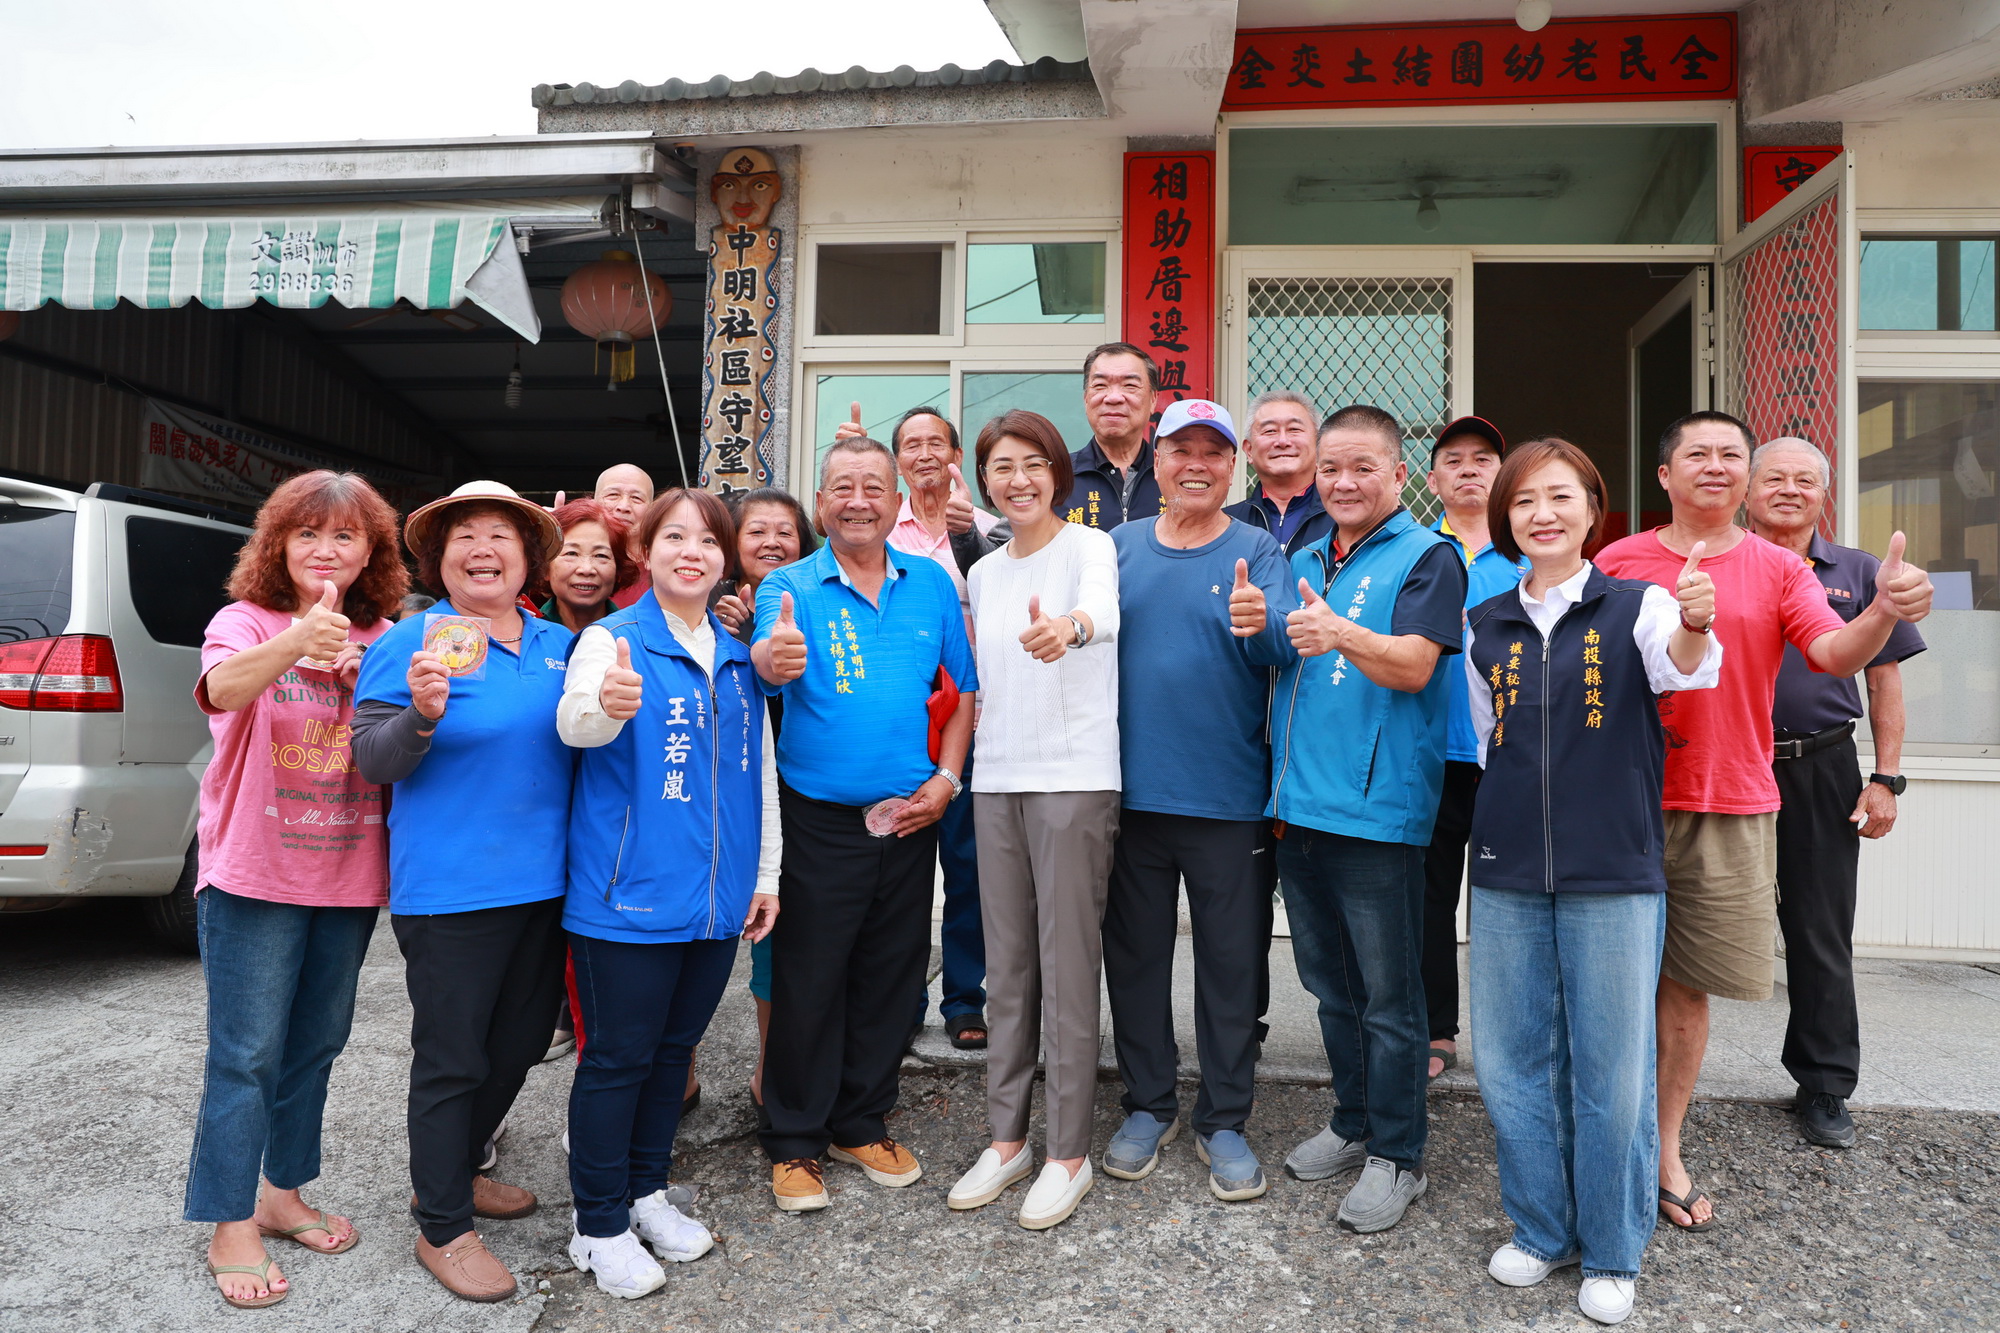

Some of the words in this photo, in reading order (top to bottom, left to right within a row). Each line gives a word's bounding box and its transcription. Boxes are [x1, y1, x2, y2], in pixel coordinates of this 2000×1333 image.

[1145, 161, 1191, 445] 相助厝邊與
[1087, 490, 1101, 530] 駐區主
[840, 608, 865, 679] 魚池鄉中明村
[1330, 575, 1372, 686] 魚池鄉表會
[1505, 641, 1523, 706] 機要秘書
[273, 688, 325, 705] OLIVE
[1583, 628, 1605, 729] 南投縣政府
[661, 696, 692, 803] 王若嵐
